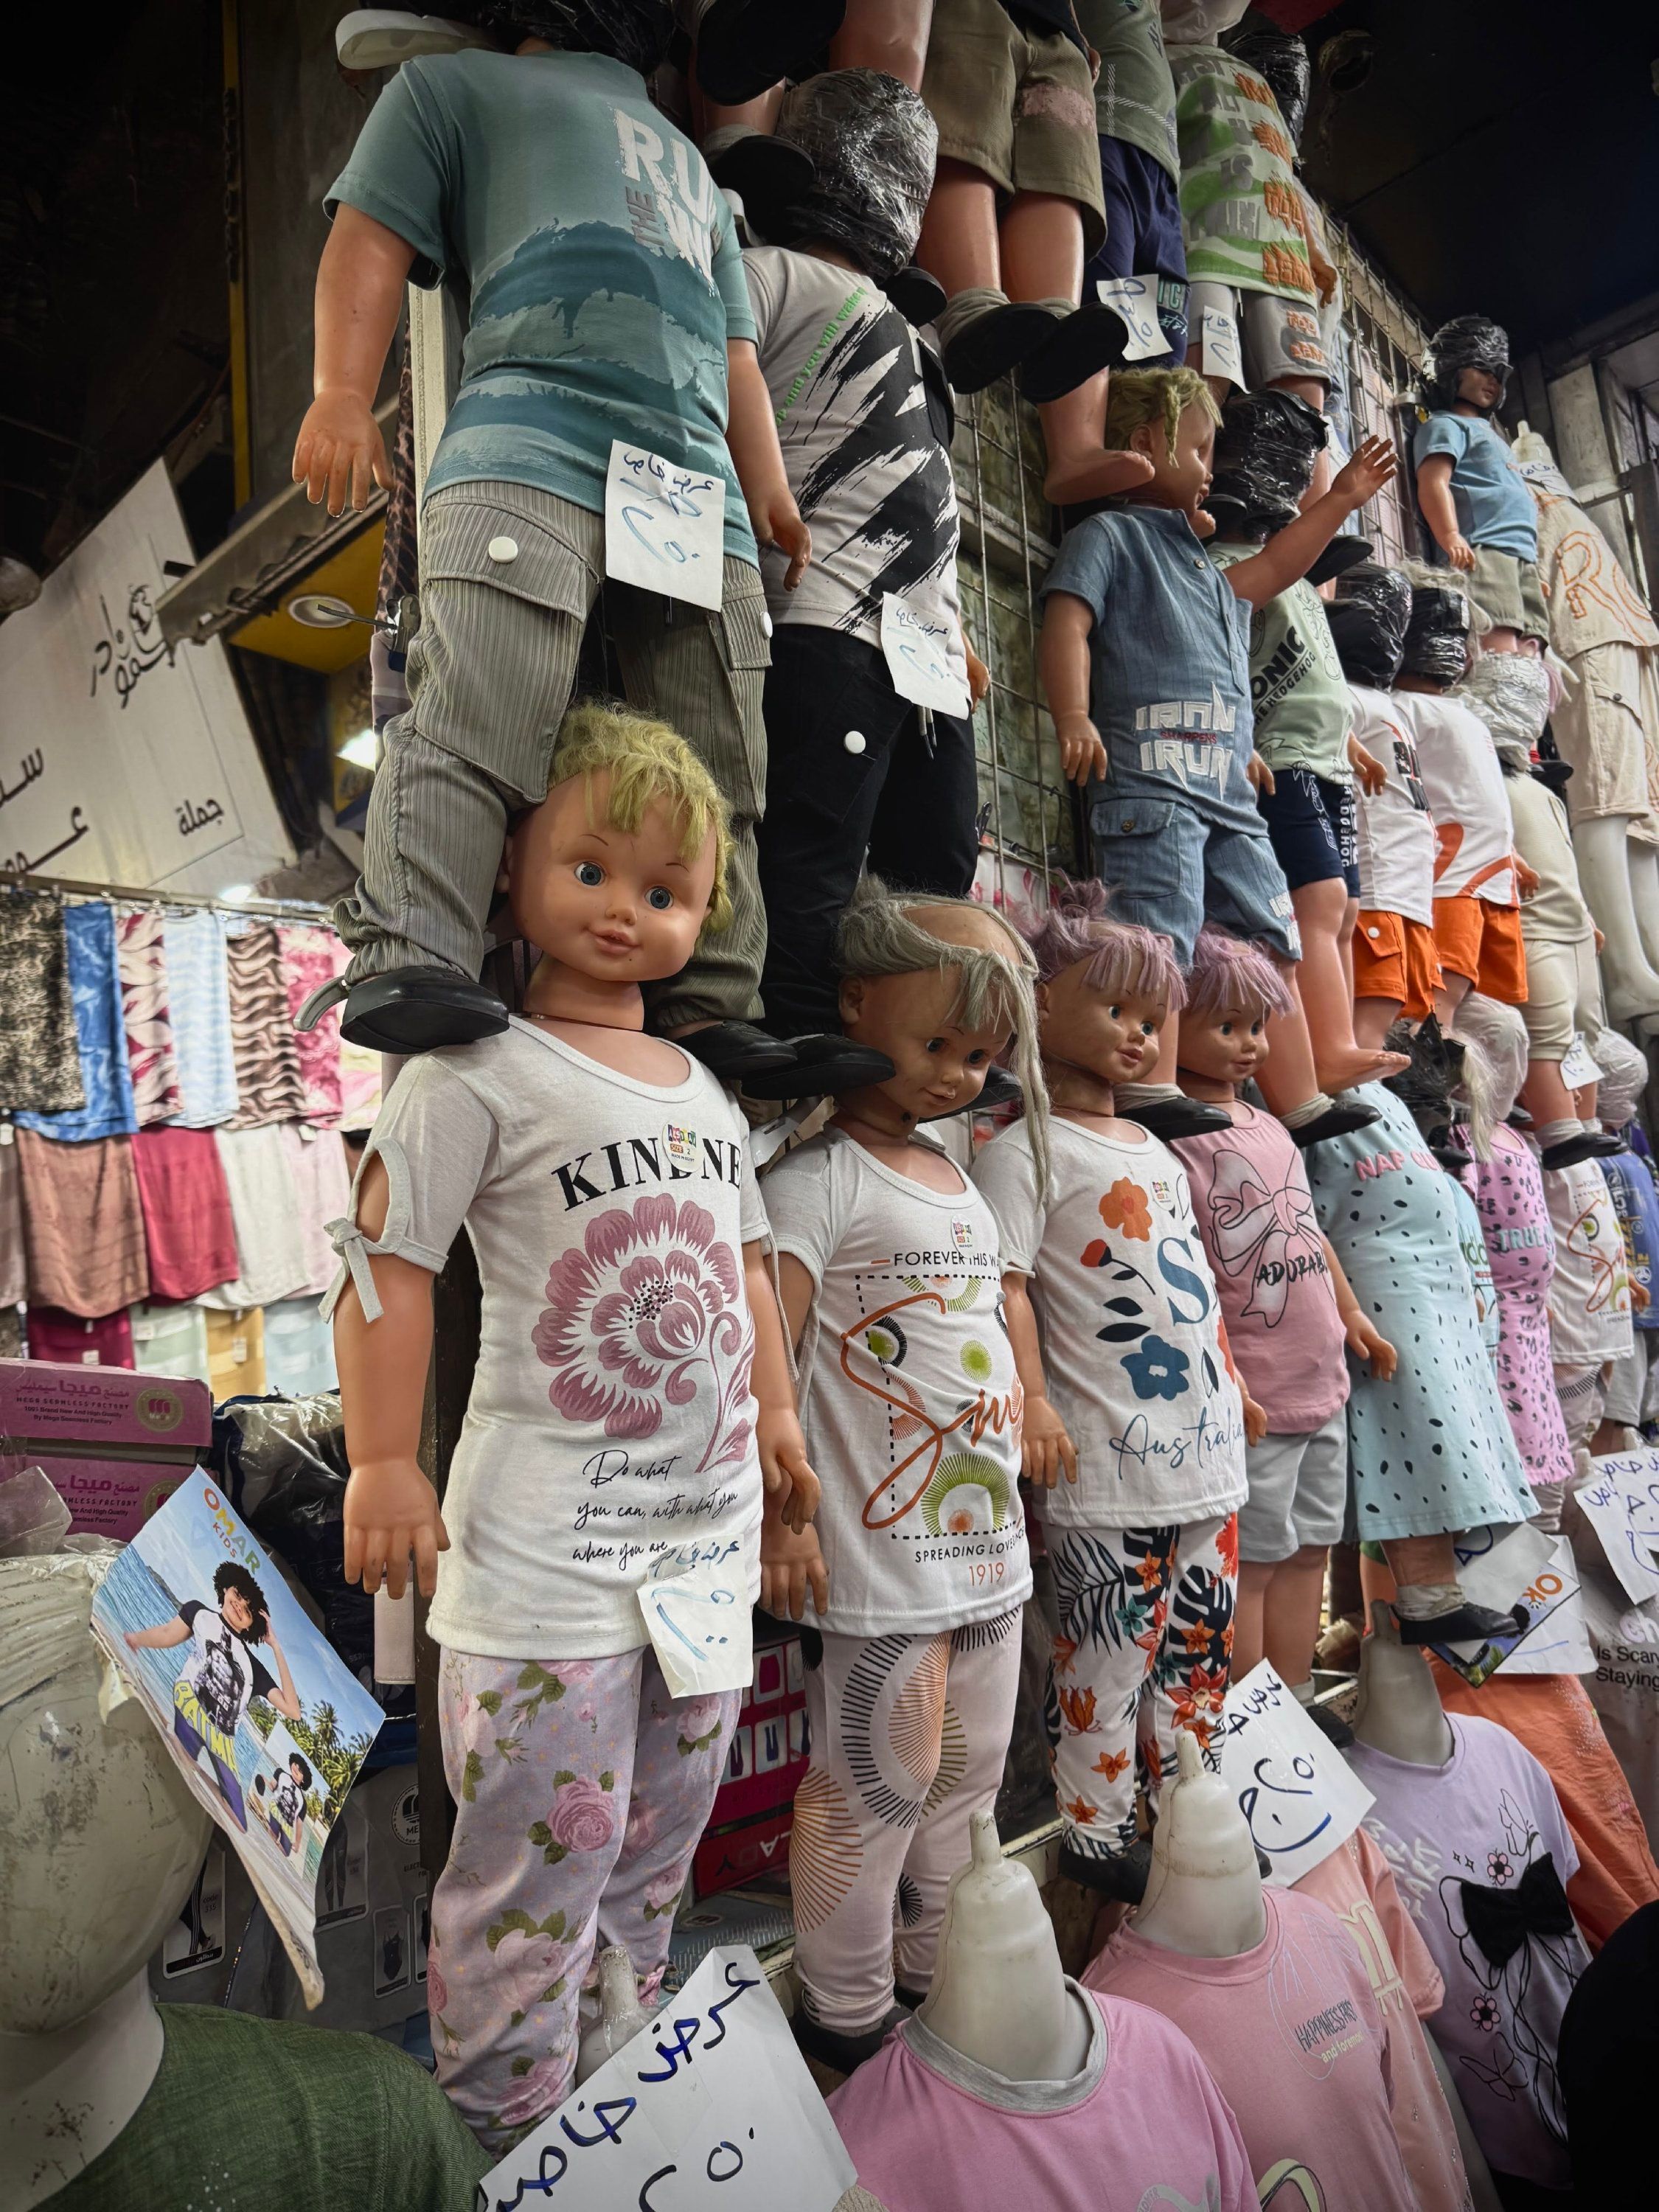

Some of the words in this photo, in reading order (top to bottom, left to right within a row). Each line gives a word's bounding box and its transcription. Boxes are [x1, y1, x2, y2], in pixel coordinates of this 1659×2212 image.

[801, 349, 823, 379] you
[818, 321, 841, 348] will
[1266, 652, 1316, 708] HEDGEHOG
[175, 799, 224, 836] جملة
[551, 1137, 741, 1212] KINNE
[1354, 1149, 1405, 1181] NAP
[1496, 1225, 1544, 1252] TRUE
[894, 1251, 965, 1266] FOREVER
[1255, 1251, 1328, 1289] ADORAB
[59, 1380, 102, 1397] ميجا
[70, 1475, 113, 1495] ميجا
[582, 1450, 628, 1489] Do
[635, 1455, 683, 1481] what
[114, 1481, 140, 1496] مصنع
[574, 1502, 611, 1530] you
[617, 1506, 647, 1519] can,
[653, 1493, 686, 1520] with
[686, 1487, 720, 1517] what
[711, 1491, 738, 1519] you
[204, 1488, 261, 1575] OMAR
[212, 1522, 237, 1558] KIDS
[572, 1540, 614, 1562] where
[619, 1542, 644, 1571] you
[649, 1540, 668, 1553] are
[915, 1544, 985, 1563] SPREADING
[968, 1562, 1005, 1586] 1919
[1616, 1645, 1659, 1664] Scar
[1321, 2042, 1339, 2064] and
